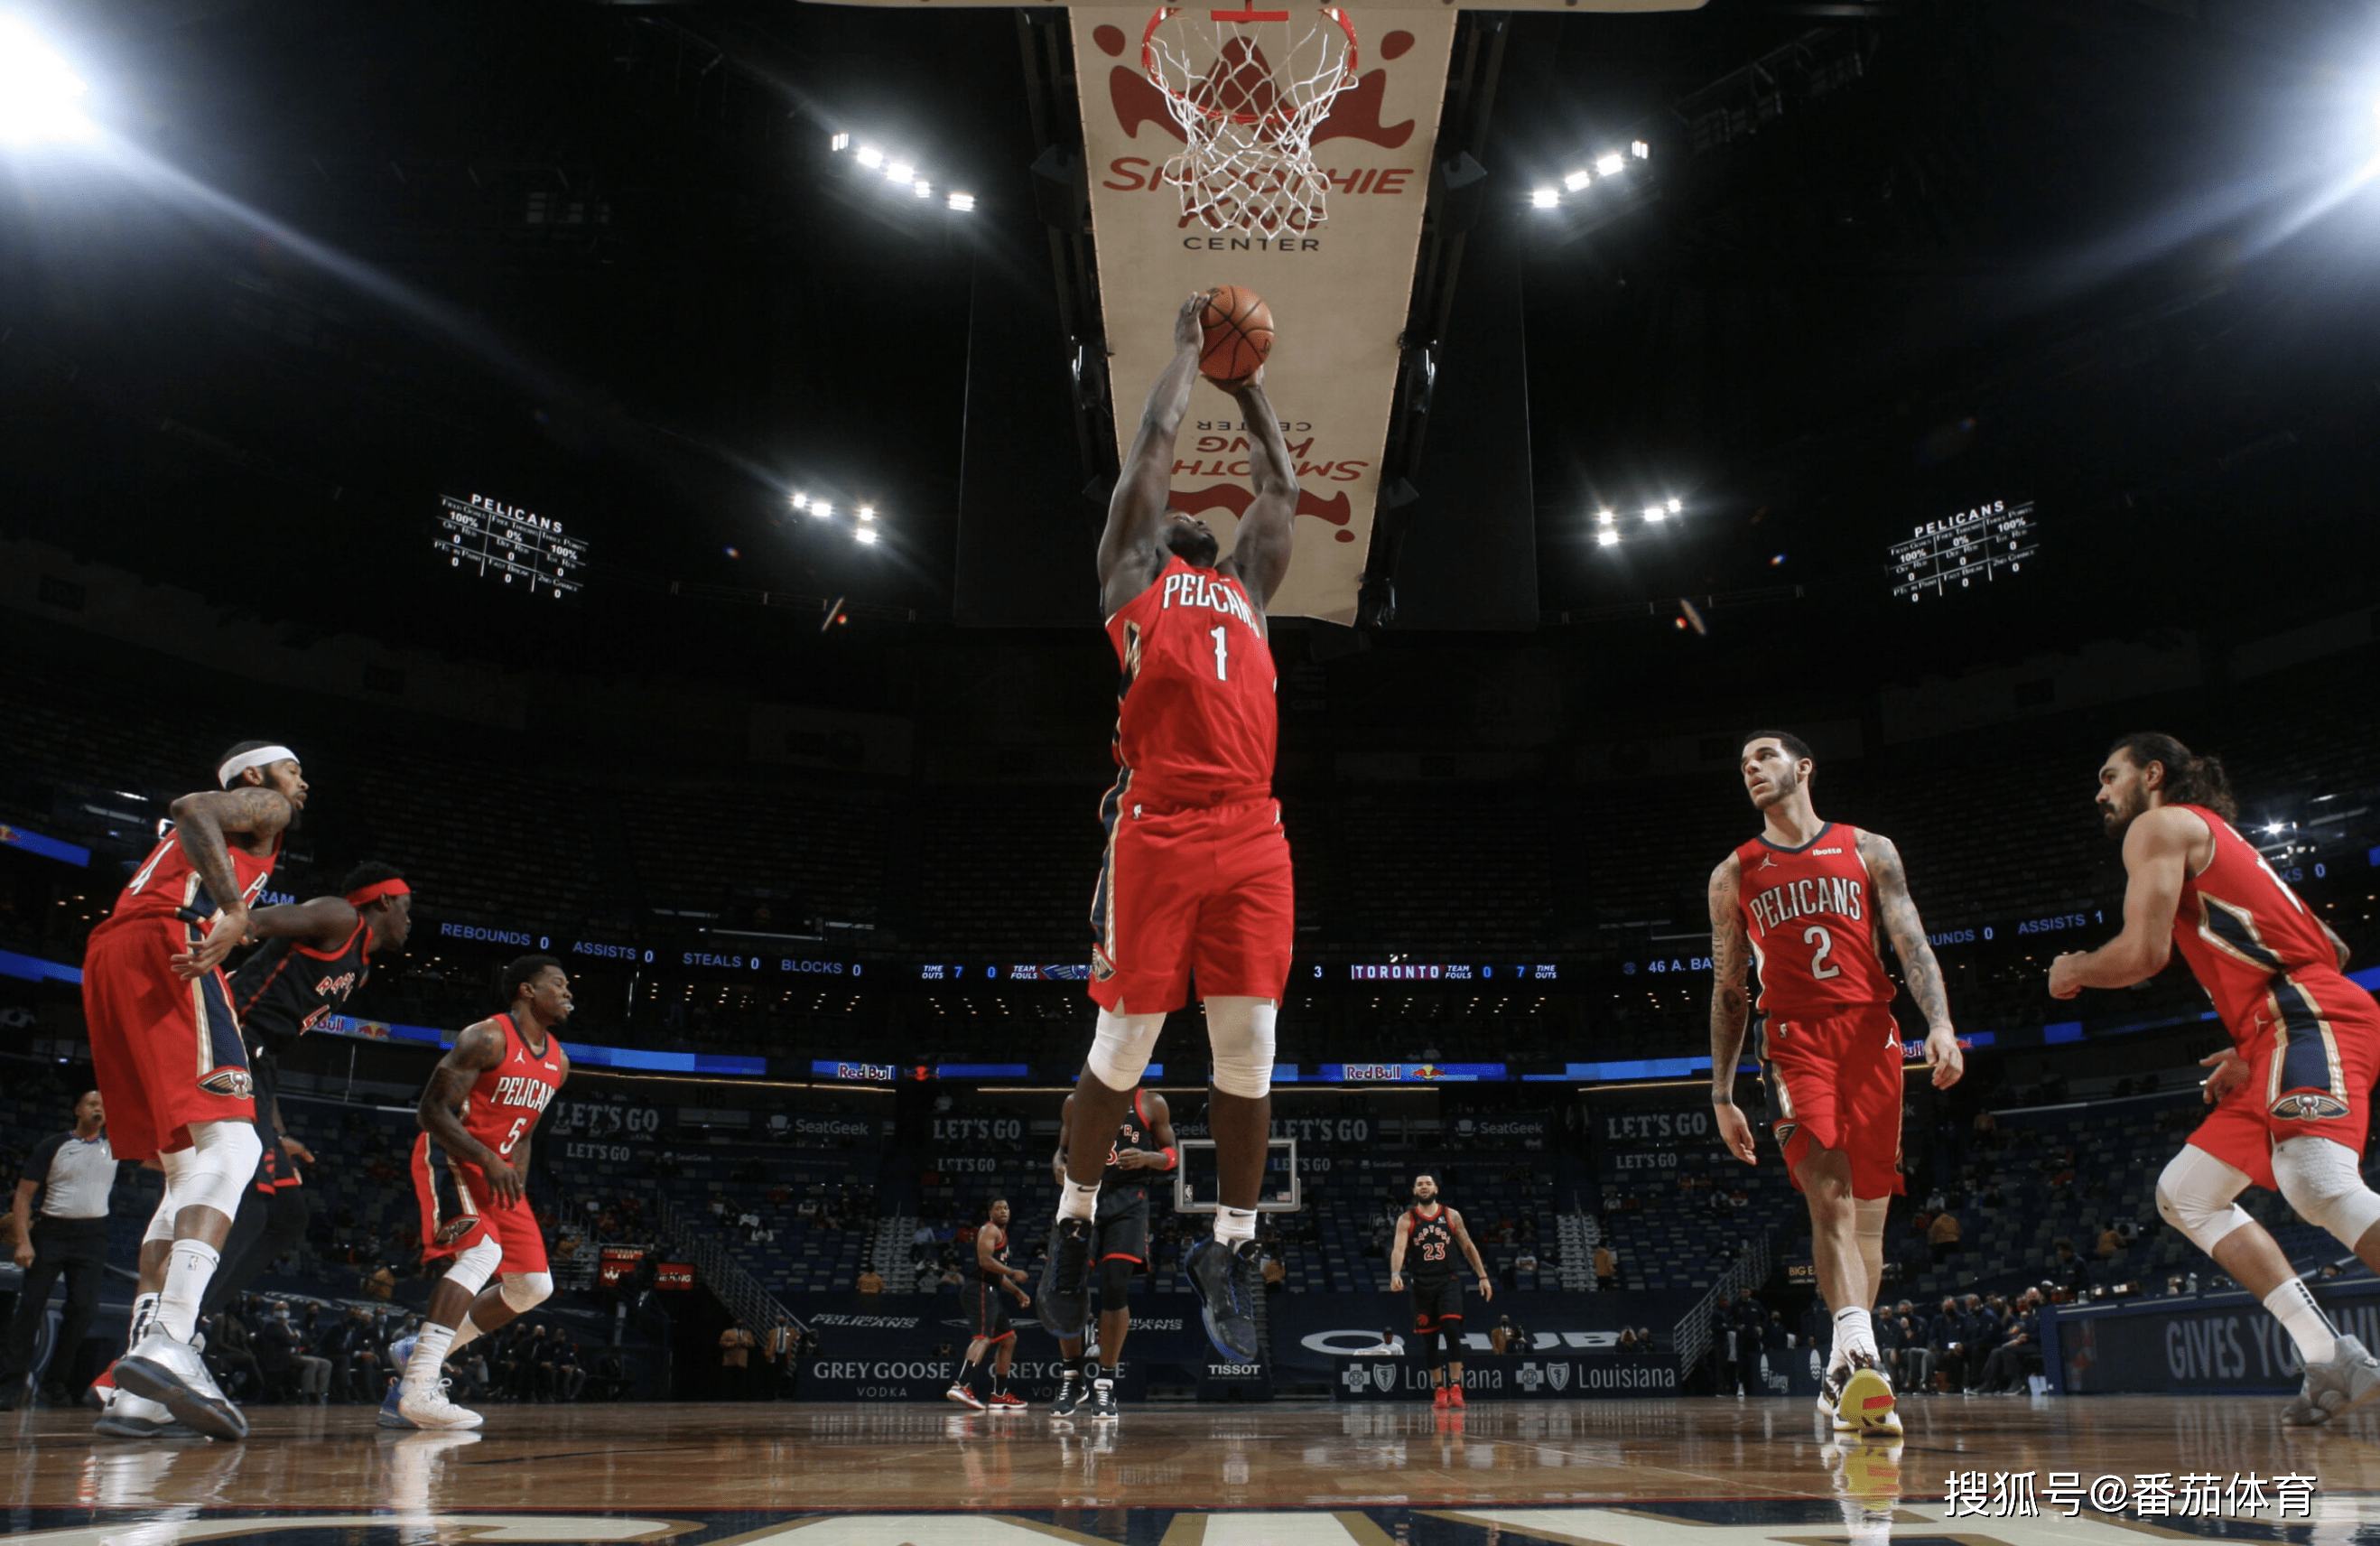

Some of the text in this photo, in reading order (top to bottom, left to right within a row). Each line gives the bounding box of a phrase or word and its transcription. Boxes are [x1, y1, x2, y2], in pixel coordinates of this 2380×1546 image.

[1183, 237, 1320, 252] CENTER
[1197, 420, 1312, 432] CETER
[1196, 436, 1315, 459] KNG
[450, 511, 479, 528] 100%
[470, 493, 562, 534] PELICANS
[1914, 500, 2005, 538] PELICANS
[1998, 517, 2026, 533] 100%
[453, 534, 461, 544] 0
[506, 529, 523, 543] 0%
[1953, 535, 1969, 547] 0%
[2010, 541, 2017, 550] 0
[507, 552, 515, 562] 0
[551, 545, 578, 561] 100%
[1900, 548, 1927, 563] 100%
[451, 557, 459, 567] 0
[1959, 557, 1966, 566] 0
[2012, 563, 2020, 572] 0
[505, 573, 512, 583] 0
[557, 567, 564, 577] 0
[1908, 573, 1915, 582] 0
[1962, 578, 1969, 587] 0
[554, 589, 562, 599] 0
[1911, 592, 1919, 602] 0
[1211, 627, 1228, 681] 1
[2315, 863, 2326, 878] 0
[257, 889, 295, 905] RAM
[1750, 877, 1862, 937] PELICANS
[1984, 927, 1994, 940] 0
[2018, 913, 2086, 935] ASSISTS
[2095, 910, 2104, 924] 1
[441, 923, 861, 976] REBOUNDS 0 ASSISTS 0 STEALS 0 BLOCKS 0
[1804, 926, 1840, 980] 2
[954, 966, 963, 978] 7
[987, 966, 996, 978] 0
[1314, 965, 1323, 978] 3
[1355, 965, 1439, 978] TORONTO
[1483, 966, 1492, 978] 0
[1517, 966, 1525, 978] 7
[1649, 960, 1666, 973] 46
[1671, 959, 1687, 972] A.
[1010, 972, 1038, 980] FOULS
[490, 1076, 556, 1113] PELICAN
[554, 1102, 660, 1132] LET'S GO
[795, 1118, 869, 1136] SeatGeek
[933, 1118, 1021, 1140] LET'S GO
[1173, 1122, 1209, 1136] Geek
[1271, 1118, 1368, 1142] LET'S GO
[1481, 1122, 1544, 1136] SeatGeek
[1608, 1112, 1707, 1140] LET'S GO
[499, 1117, 527, 1154] 5
[566, 1142, 608, 1160] LET'S
[609, 1145, 630, 1161] GO
[977, 1159, 996, 1172] GO
[1313, 1159, 1331, 1172] GO
[1616, 1152, 1678, 1169] LET'S GO
[1423, 1243, 1446, 1261] 23
[1789, 1266, 1806, 1276] BIG
[2167, 1316, 2245, 1380] GIVES
[2249, 1314, 2303, 1378] YO
[813, 1362, 951, 1379] GREY GOOSE
[1208, 1364, 1261, 1375] TISSOT
[1579, 1364, 1675, 1388] Louisiana
[857, 1387, 907, 1398] VODKA
